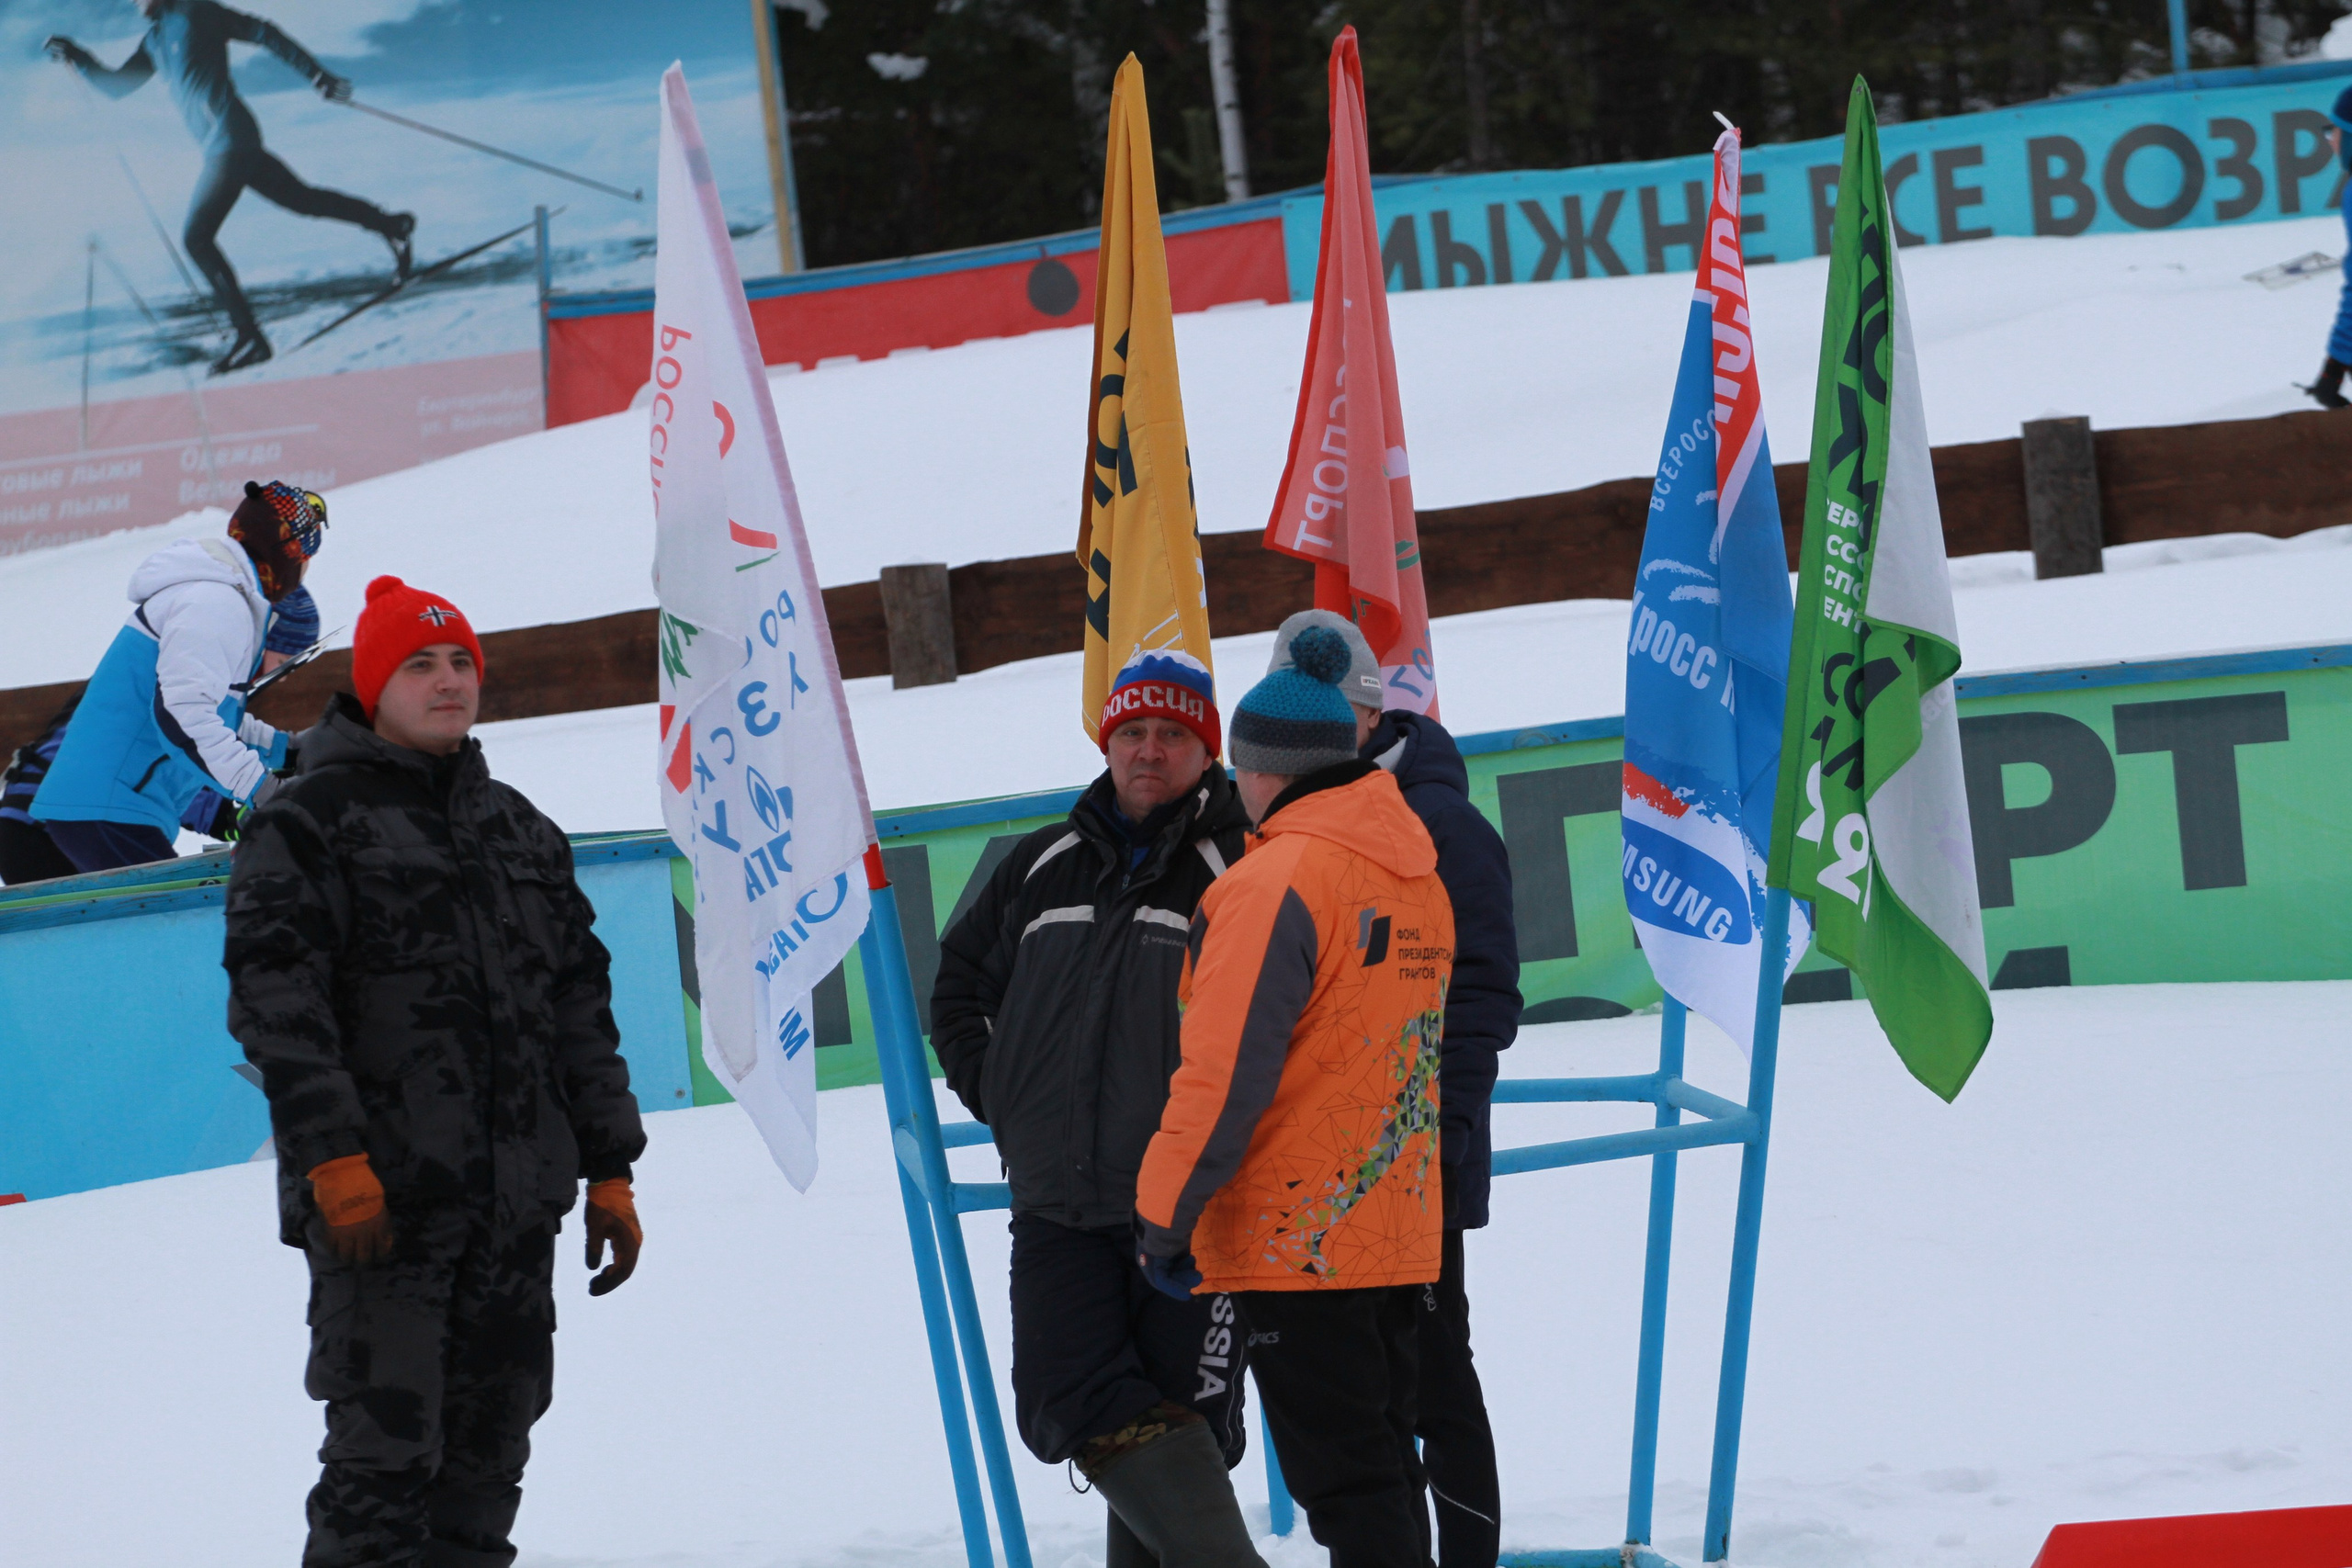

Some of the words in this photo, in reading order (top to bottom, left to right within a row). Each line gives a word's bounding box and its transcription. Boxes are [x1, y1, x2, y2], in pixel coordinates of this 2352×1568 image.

[2028, 108, 2343, 237] ВОЗР
[1102, 685, 1204, 728] РОССИЯ
[1396, 928, 1420, 942] ФОНД
[1398, 966, 1436, 980] ГРАНТОВ
[1194, 1292, 1235, 1402] SSIA
